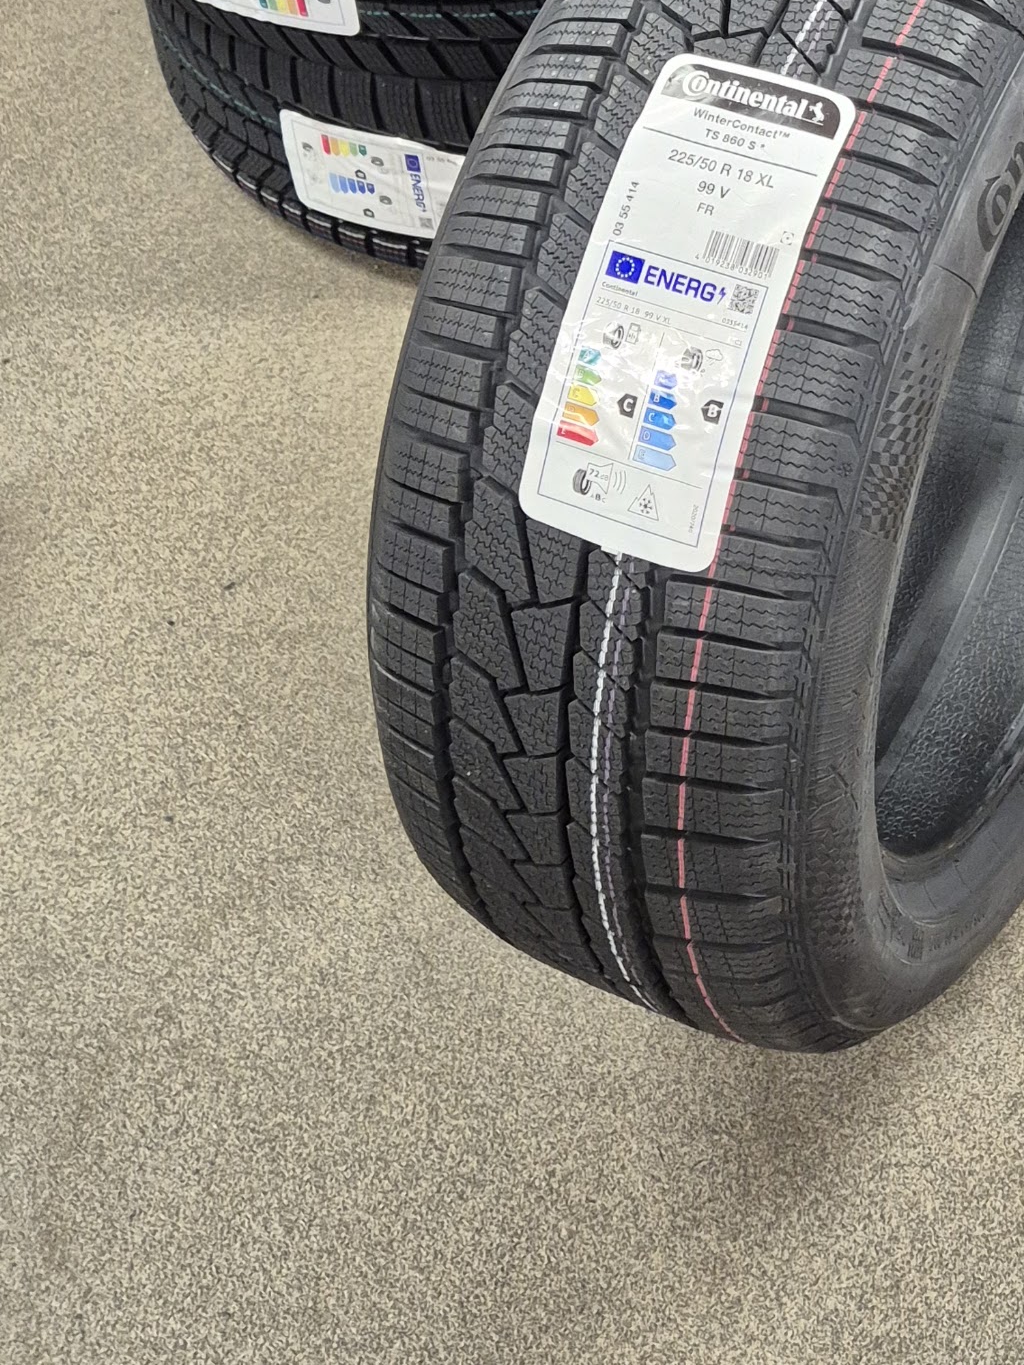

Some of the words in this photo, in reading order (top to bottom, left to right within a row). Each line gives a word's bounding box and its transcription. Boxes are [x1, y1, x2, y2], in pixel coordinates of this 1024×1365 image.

[682, 70, 809, 119] Continental
[705, 128, 720, 140] TS
[722, 133, 745, 148] 860
[747, 140, 757, 150] S
[668, 149, 717, 172] 225/50
[719, 162, 732, 177] R
[737, 168, 754, 183] 18
[754, 172, 775, 189] XL
[626, 180, 640, 203] 414
[696, 180, 715, 195] 99
[720, 186, 731, 199] V
[618, 204, 631, 220] 55
[696, 202, 715, 216] FR
[612, 220, 625, 237] 03
[601, 281, 640, 298] Continental
[643, 264, 718, 303] ENERG
[596, 296, 623, 310] 225/50
[643, 309, 655, 319] 99
[622, 399, 633, 412] C
[707, 404, 719, 418] B
